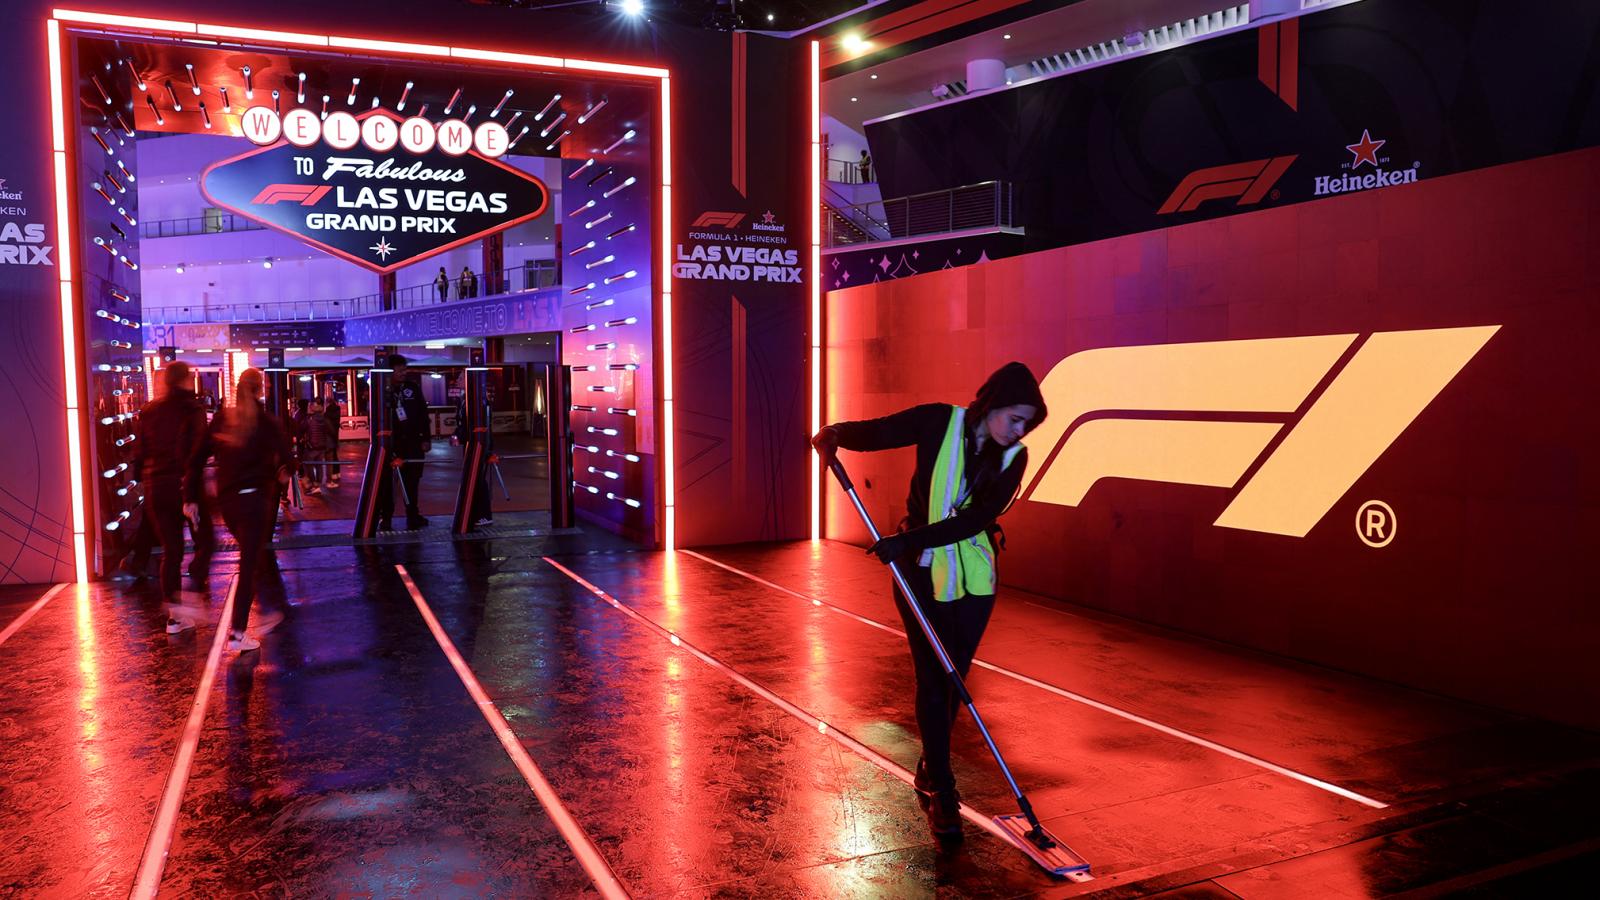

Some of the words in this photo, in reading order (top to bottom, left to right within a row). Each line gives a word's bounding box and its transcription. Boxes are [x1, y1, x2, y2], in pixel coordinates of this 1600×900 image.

[250, 112, 498, 151] WELCOME
[294, 157, 314, 176] TO
[322, 156, 466, 182] Fabulous
[1314, 168, 1418, 195] Heineken
[337, 186, 398, 210] LAS
[404, 189, 508, 213] VEGAS
[306, 213, 397, 232] GRAND
[402, 216, 456, 234] PRIX
[752, 222, 785, 232] Heineken
[689, 232, 731, 241] FORMULA
[745, 235, 787, 244] HEINEKEN
[677, 244, 721, 262] LAS
[725, 246, 798, 265] VEGAS
[672, 262, 750, 280] GRAND
[753, 265, 802, 283] PRIX
